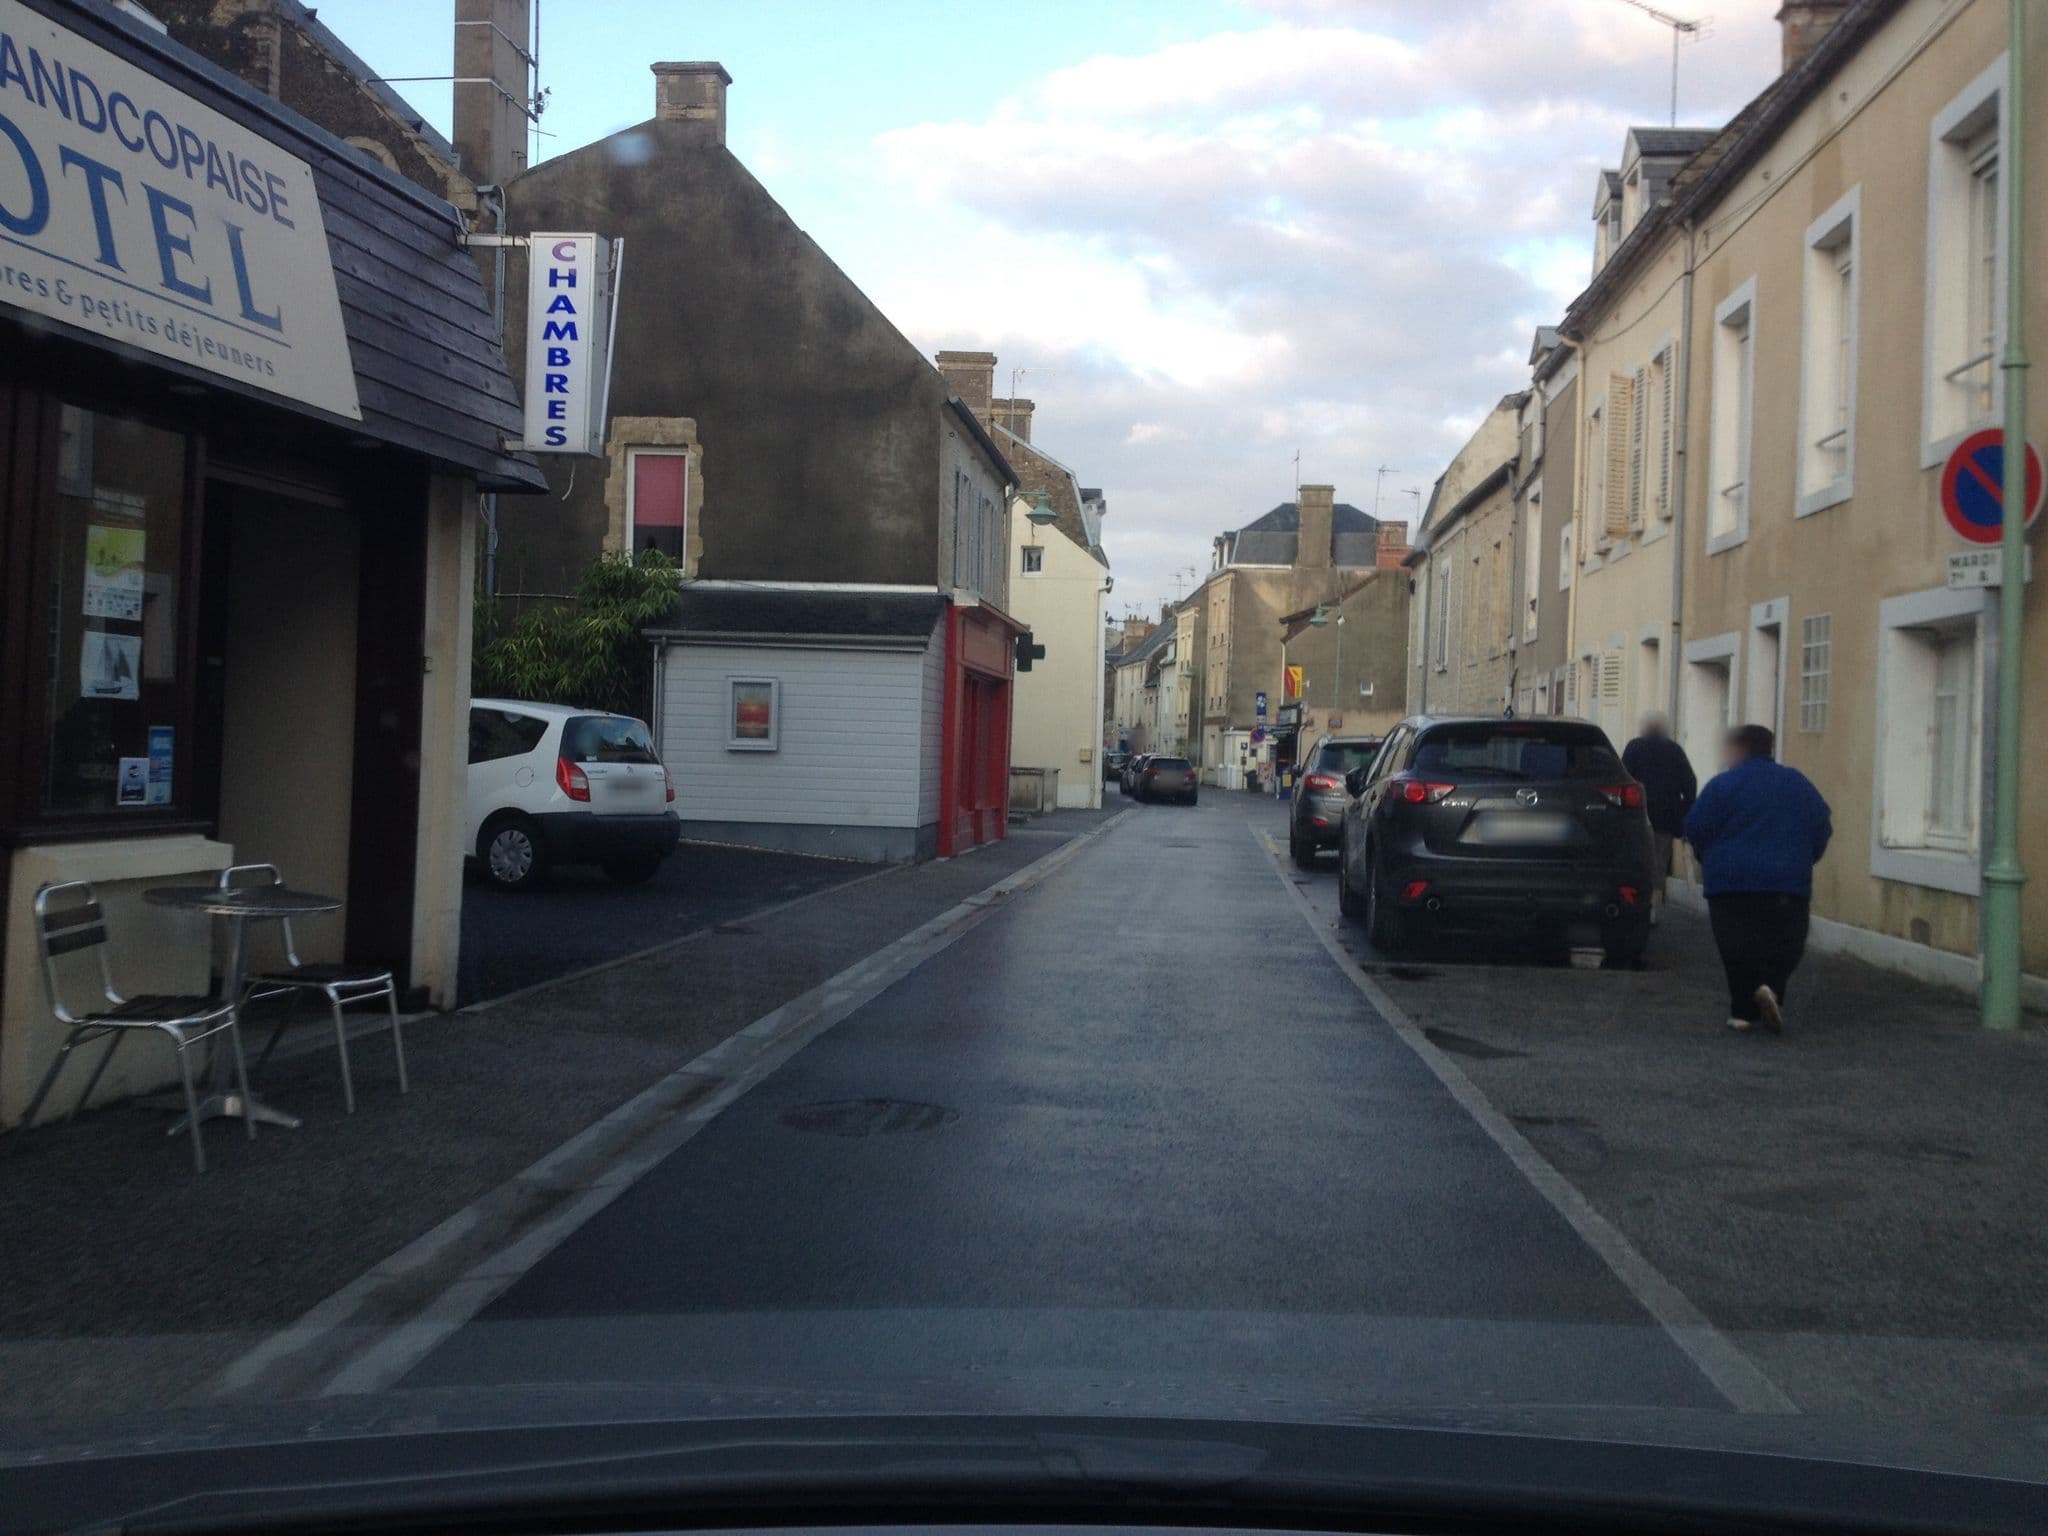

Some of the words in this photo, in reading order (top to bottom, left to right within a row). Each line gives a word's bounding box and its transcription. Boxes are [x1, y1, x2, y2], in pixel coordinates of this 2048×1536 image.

[0, 263, 50, 298] res
[55, 278, 73, 306] &
[79, 291, 158, 335] petits
[163, 317, 276, 377] déjeuners
[542, 241, 579, 447] CHAMBRES
